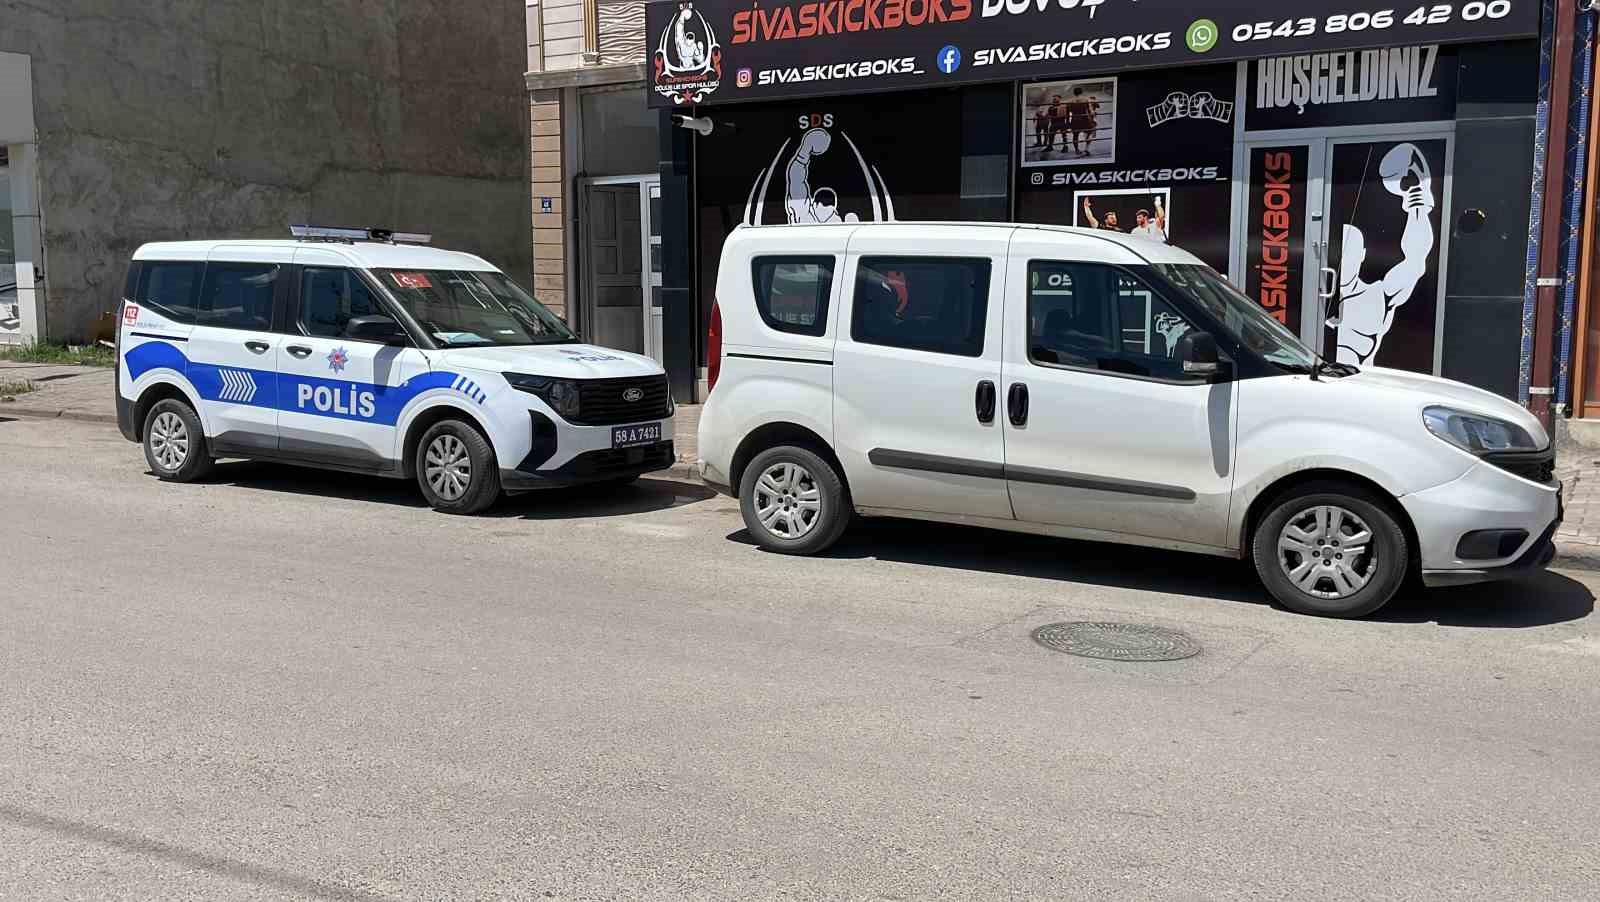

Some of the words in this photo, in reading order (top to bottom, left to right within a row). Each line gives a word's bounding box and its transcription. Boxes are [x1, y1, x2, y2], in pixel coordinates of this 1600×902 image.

[1232, 18, 1316, 42] 0543
[1325, 10, 1394, 33] 806
[1403, 5, 1452, 25] 42
[1461, 0, 1511, 20] 00
[973, 32, 1172, 66] SIVASKICKBOKS
[799, 113, 833, 129] SDS
[298, 383, 376, 418] POLİS
[615, 430, 628, 443] 58
[629, 428, 637, 441] A
[638, 425, 660, 440] 7421
